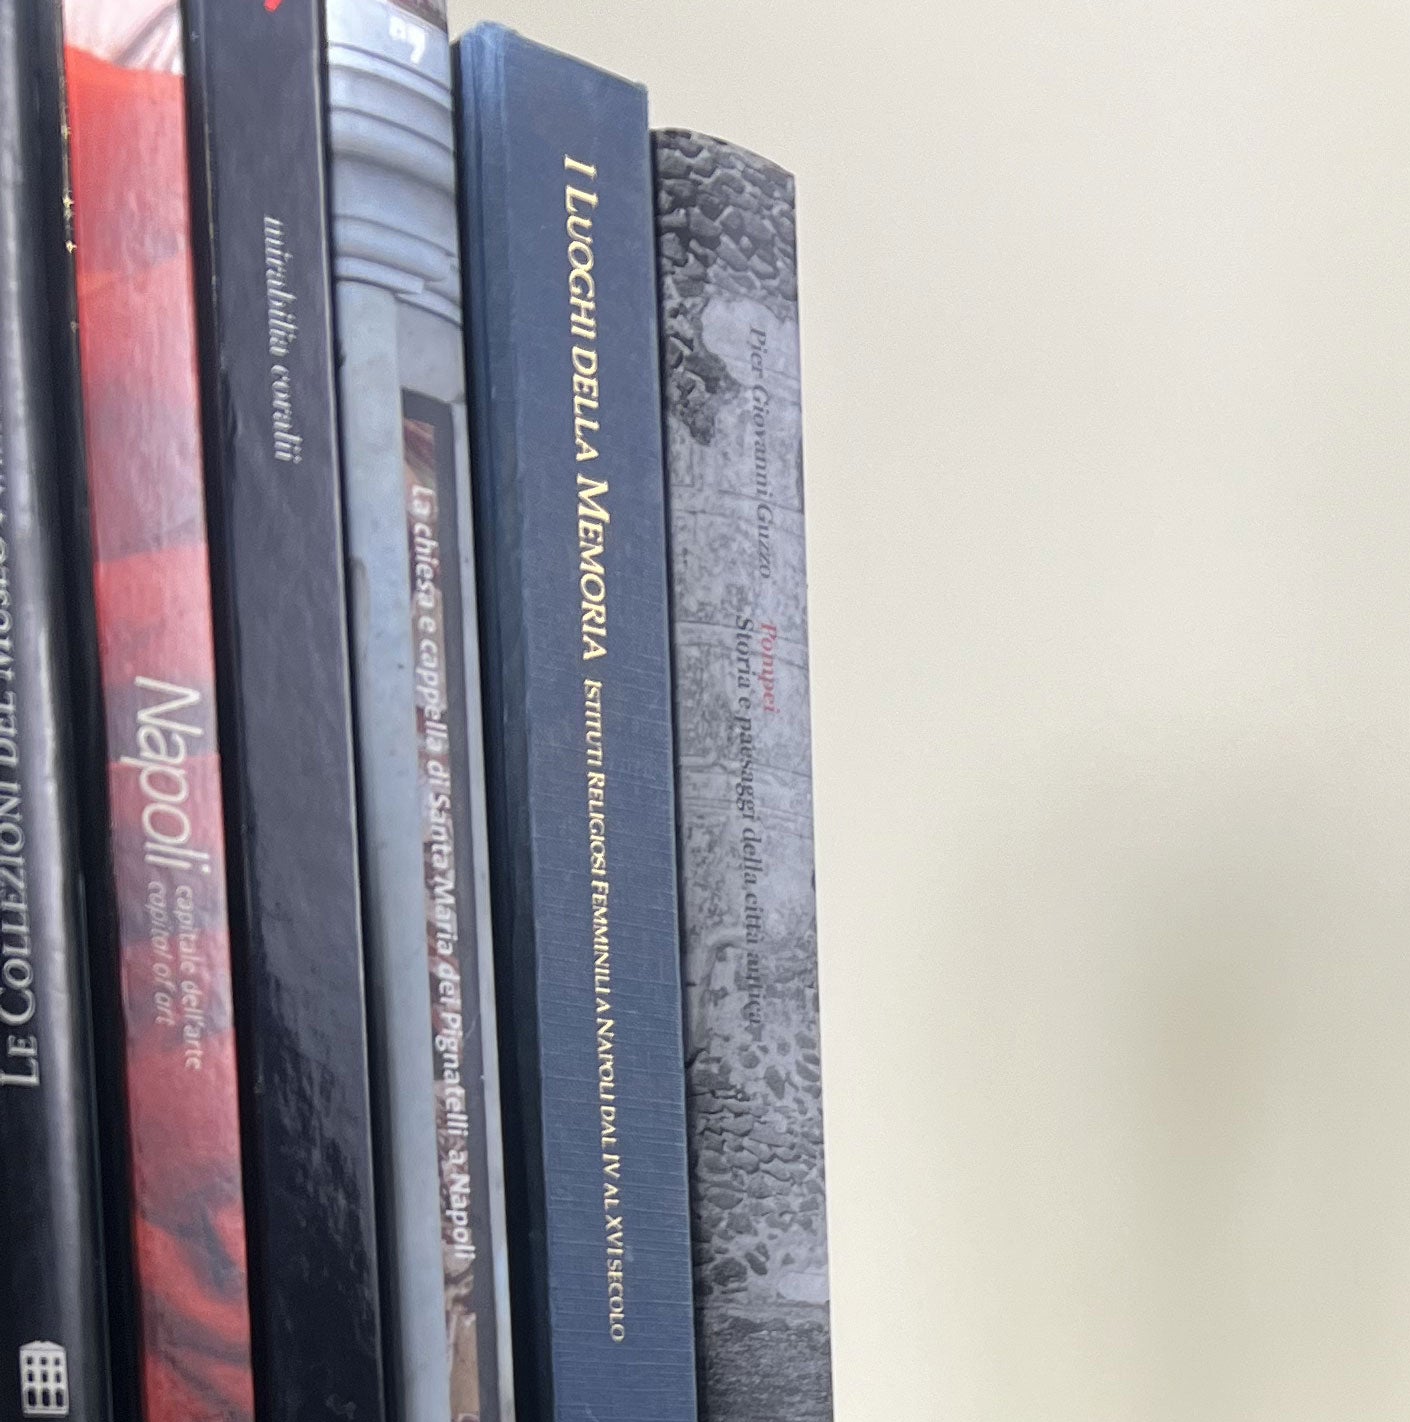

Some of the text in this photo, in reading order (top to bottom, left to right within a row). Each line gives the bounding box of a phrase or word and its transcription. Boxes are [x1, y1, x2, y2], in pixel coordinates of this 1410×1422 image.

[263, 214, 303, 465] mirabilia coralii
[749, 327, 775, 579] Pier Giovanni Guzzo
[411, 484, 437, 514] La
[414, 522, 441, 607] chiesa
[418, 615, 436, 633] e
[734, 614, 756, 688] Storia
[417, 638, 448, 751] cappella
[739, 695, 752, 709] e
[756, 622, 781, 714] Pompei
[120, 675, 210, 874] Napoli
[427, 759, 450, 785] di
[564, 154, 626, 1343] I LUOGHI DELLA MEMORIA ISTITUTI RELIGIOSI FEMMINILI A NAPOLI DAL IV AL XVI SECOLO
[734, 714, 760, 819] paesaggi
[428, 793, 453, 868] Santa
[741, 827, 764, 885] della
[174, 884, 202, 973] capitale
[433, 876, 458, 955] Maria
[151, 962, 176, 988] of
[154, 993, 176, 1026] art
[744, 950, 766, 1024] antica
[0, 1035, 39, 1087] LE
[433, 1011, 468, 1137] Pignatelli
[447, 1150, 465, 1165] a
[443, 1173, 476, 1260] Napoli
